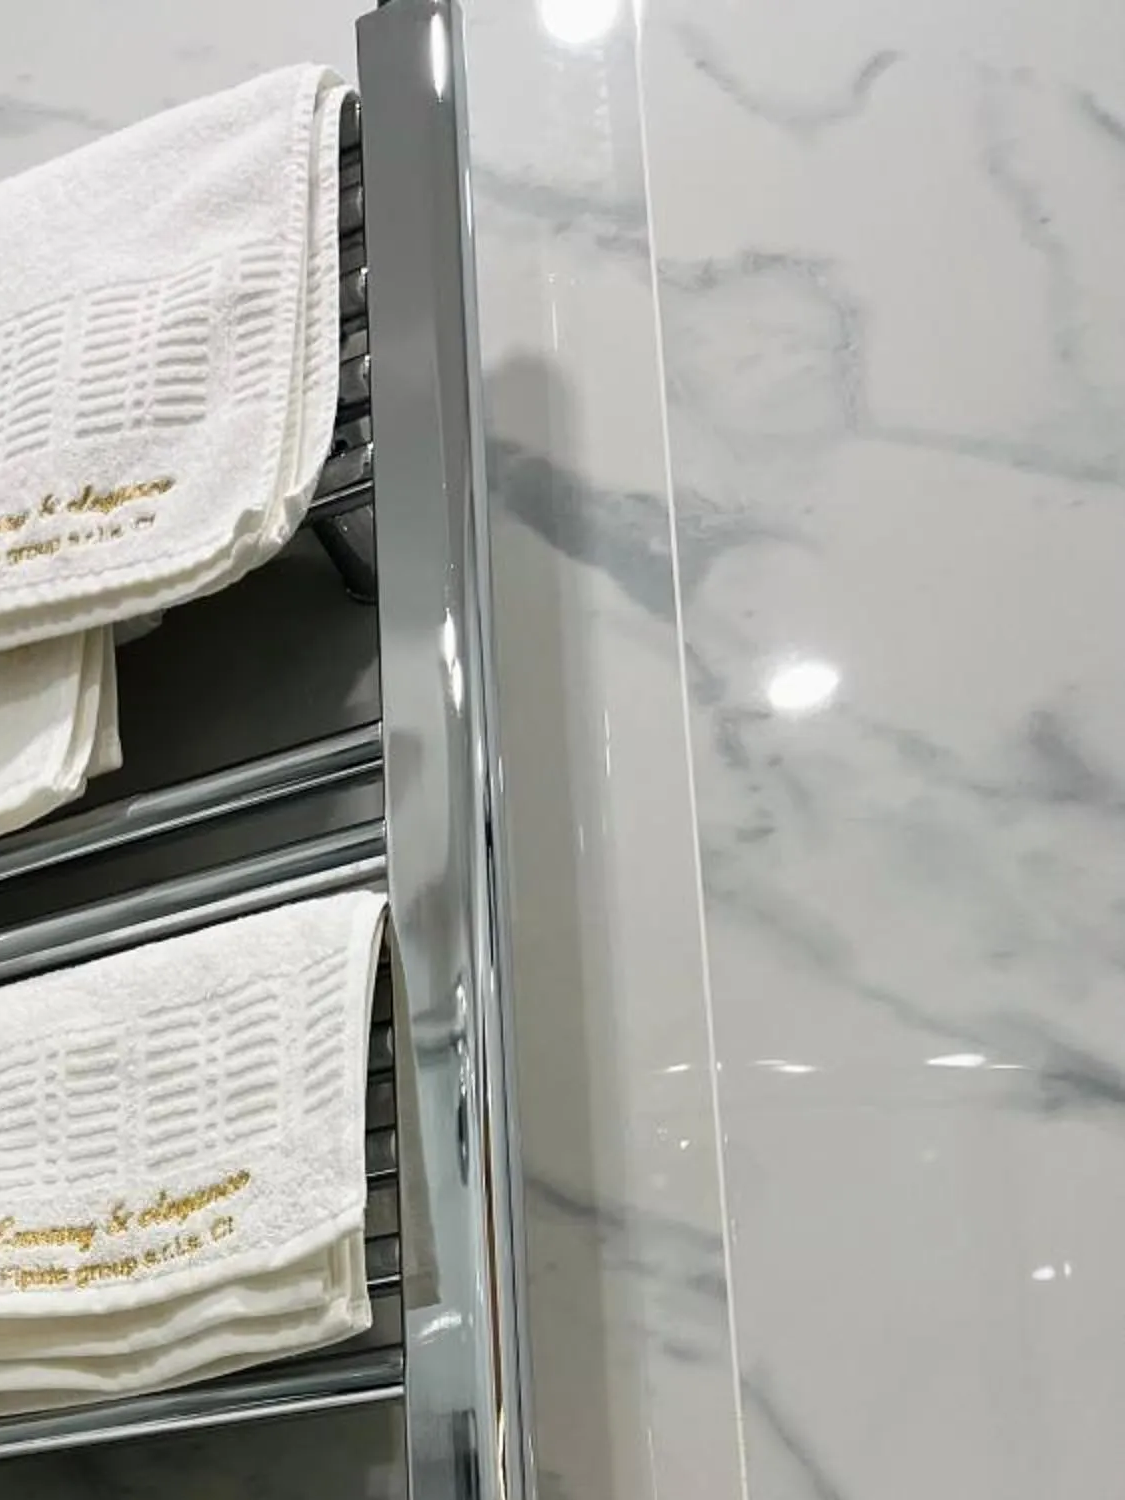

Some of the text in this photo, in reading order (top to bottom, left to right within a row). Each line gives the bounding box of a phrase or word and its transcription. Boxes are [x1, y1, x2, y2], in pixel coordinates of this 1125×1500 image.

[38, 493, 61, 517] &
[6, 535, 61, 565] group
[107, 1197, 134, 1234] &
[138, 1169, 252, 1226] elegance
[74, 1256, 138, 1289] group
